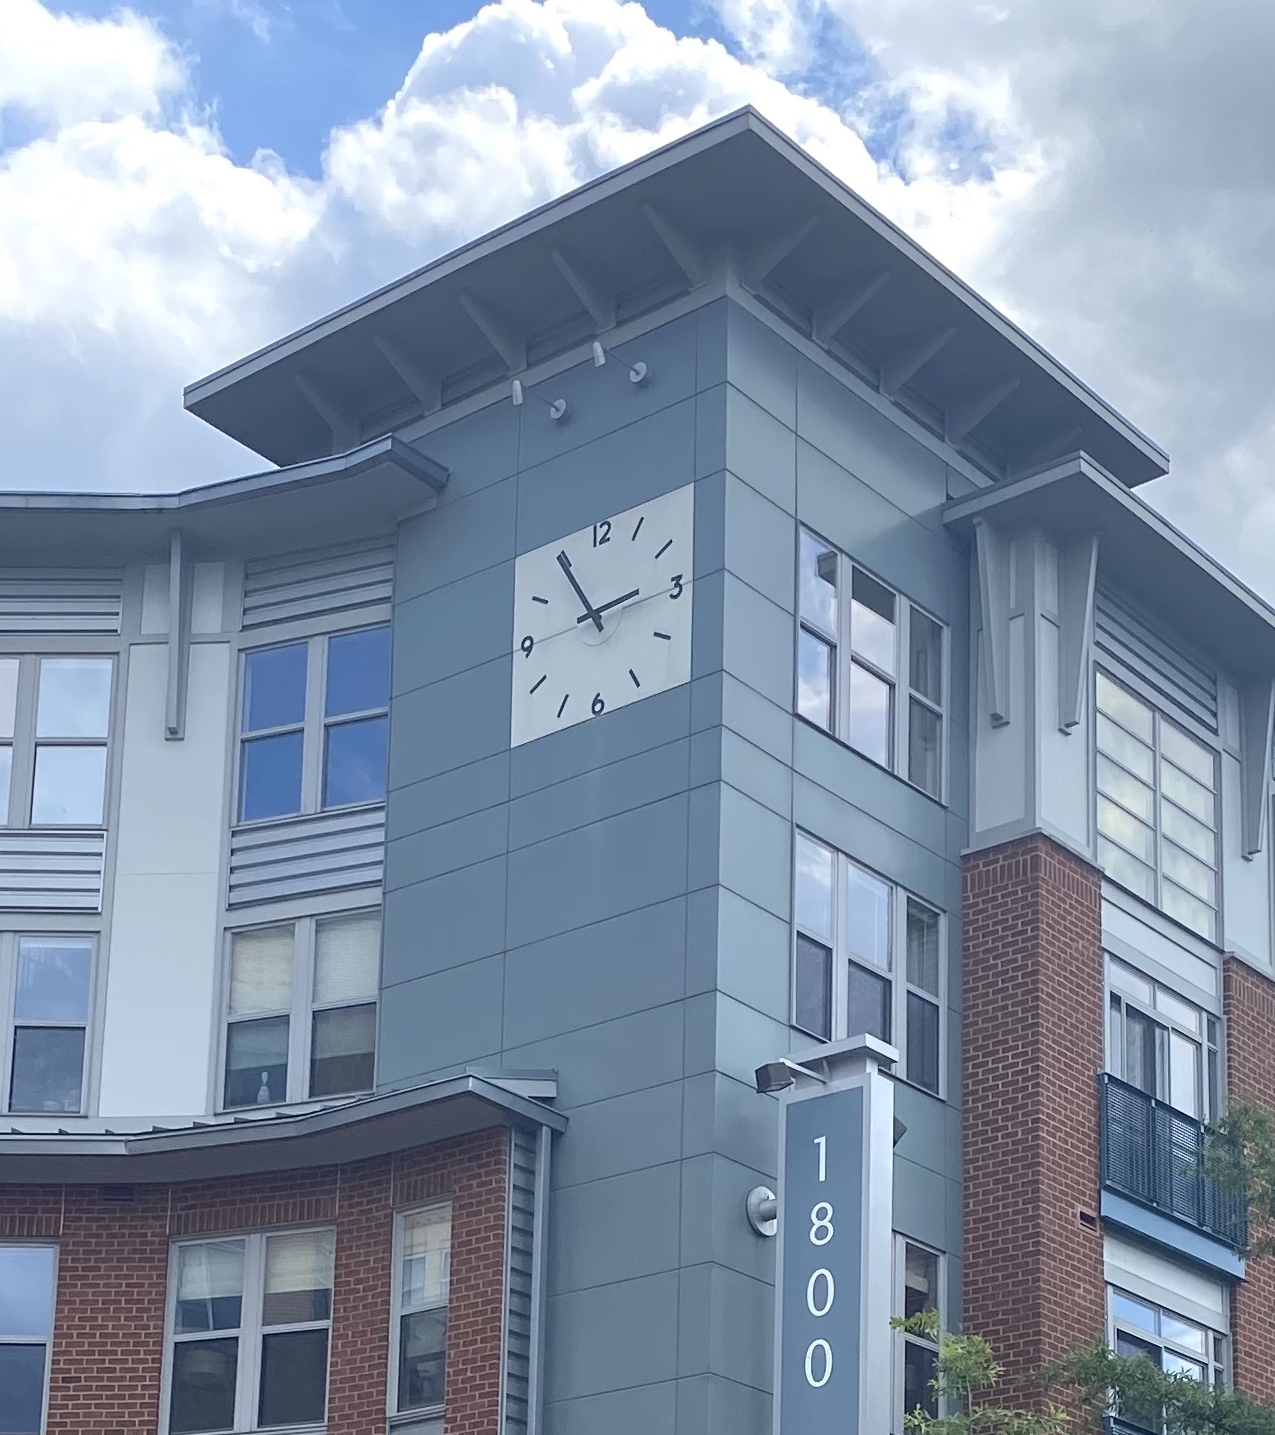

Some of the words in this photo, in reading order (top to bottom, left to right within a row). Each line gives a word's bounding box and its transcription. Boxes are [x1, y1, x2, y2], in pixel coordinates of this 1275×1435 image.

[593, 520, 612, 548] 12
[669, 573, 684, 600] 3
[520, 635, 535, 659] 9
[590, 692, 605, 717] 6
[804, 1135, 835, 1388] 1800
